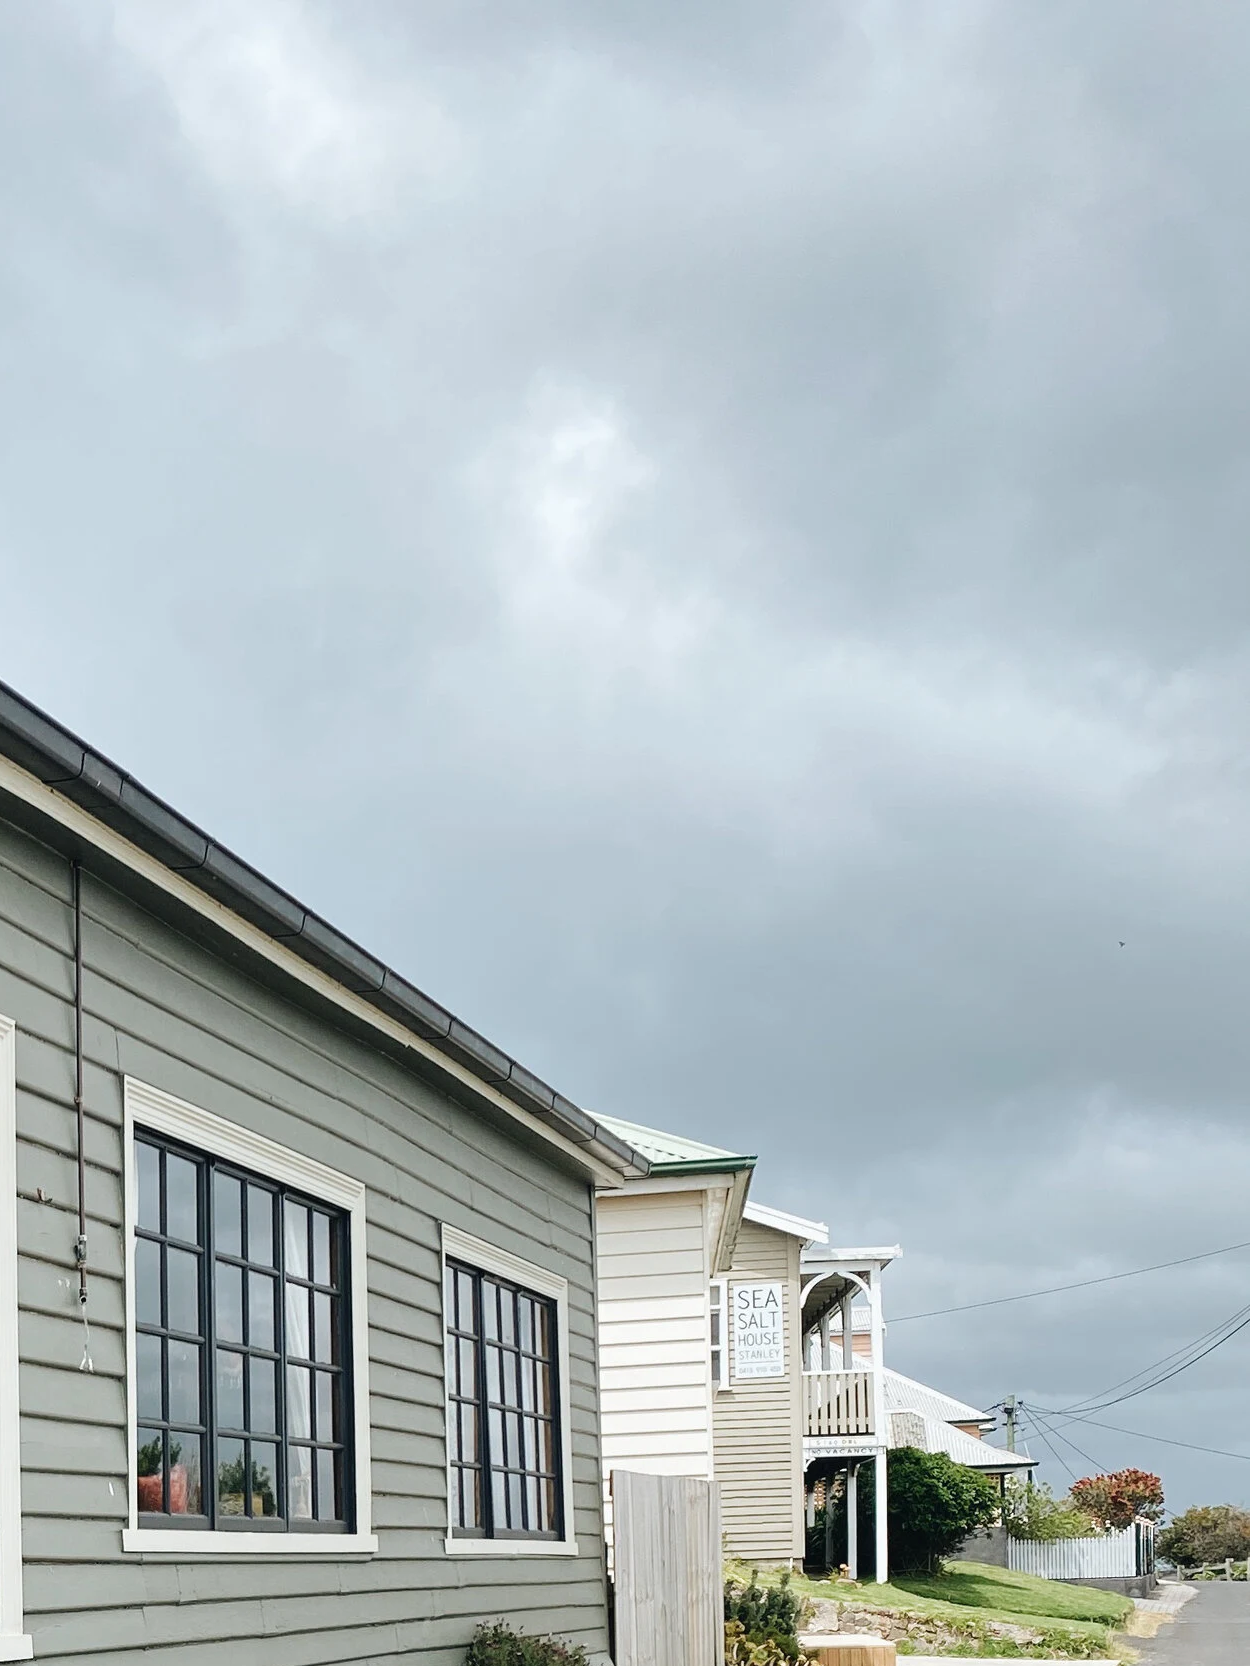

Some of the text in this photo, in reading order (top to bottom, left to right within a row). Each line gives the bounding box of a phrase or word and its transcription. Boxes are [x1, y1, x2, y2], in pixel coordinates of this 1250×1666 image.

[738, 1289, 778, 1310] SEA
[738, 1311, 779, 1330] SALT
[738, 1332, 780, 1346] HOUSE
[738, 1349, 781, 1360] STANLEY
